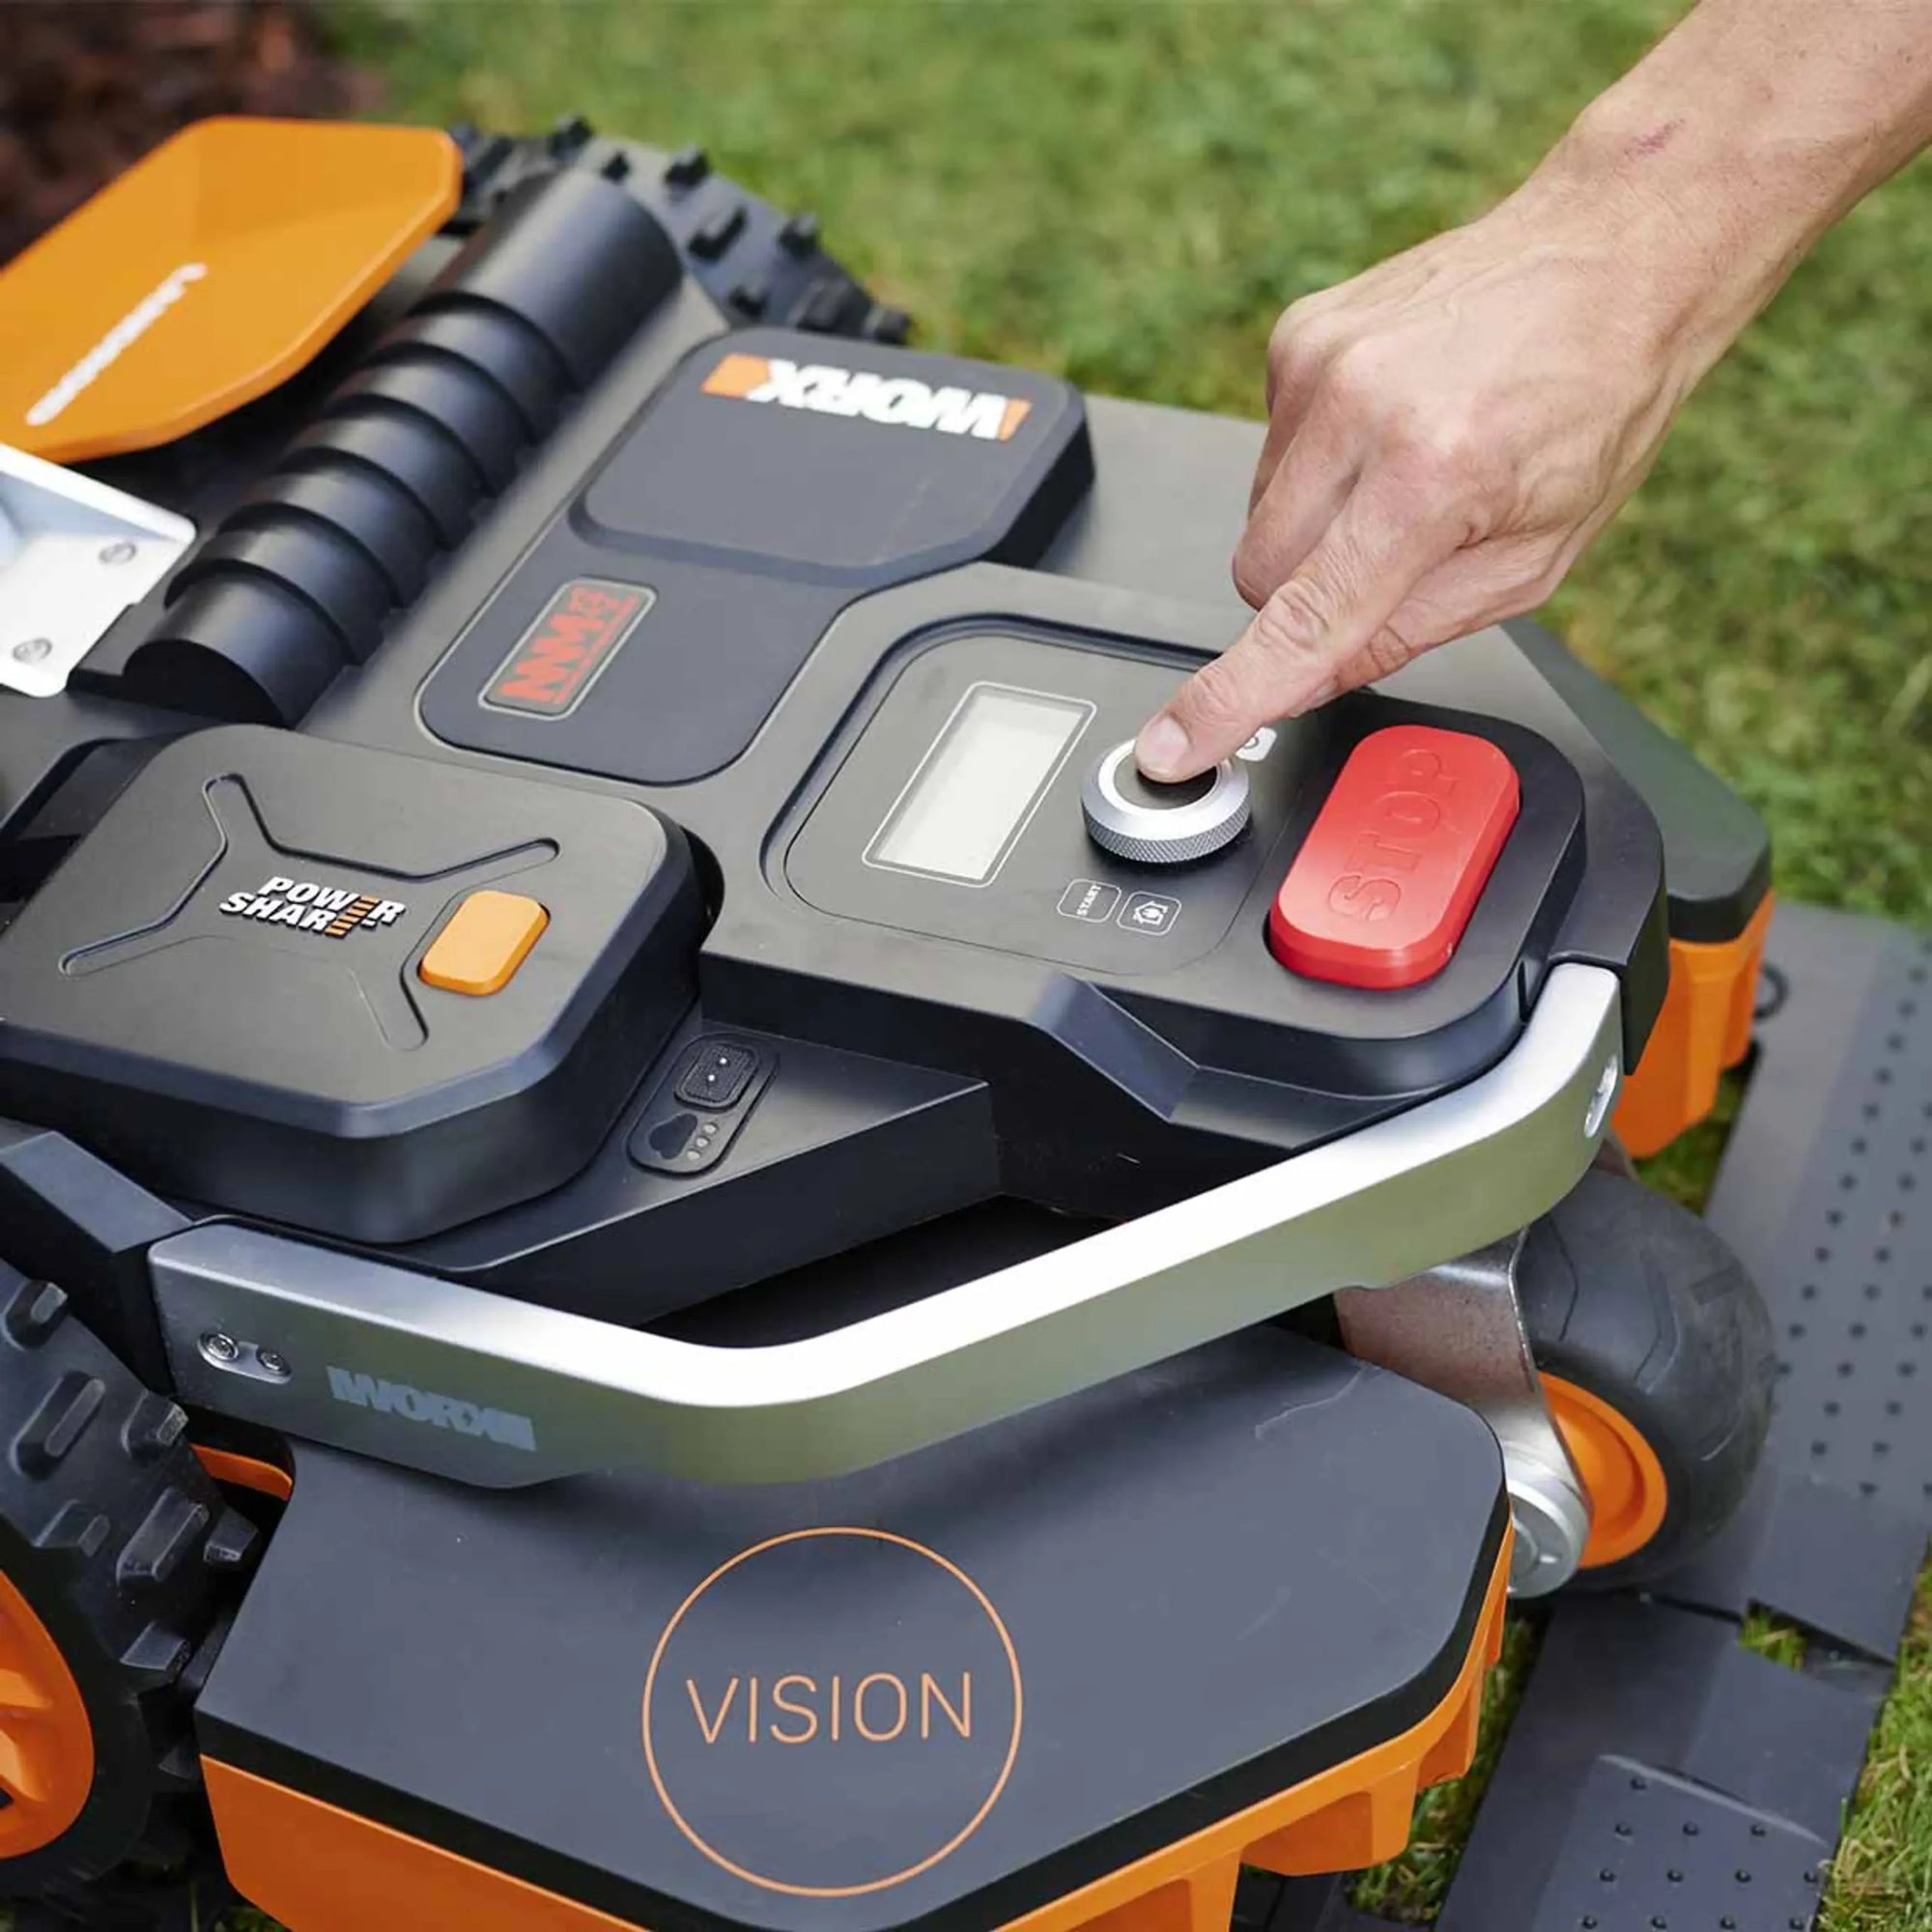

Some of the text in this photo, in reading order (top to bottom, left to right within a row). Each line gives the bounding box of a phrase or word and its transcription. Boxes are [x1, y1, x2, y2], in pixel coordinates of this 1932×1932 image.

[746, 359, 1008, 440] WORX
[1327, 748, 1455, 922] STOP
[219, 893, 358, 936] SHARE
[257, 876, 406, 924] POWER
[327, 1366, 495, 1443] WORX
[686, 1672, 971, 1744] VISION
